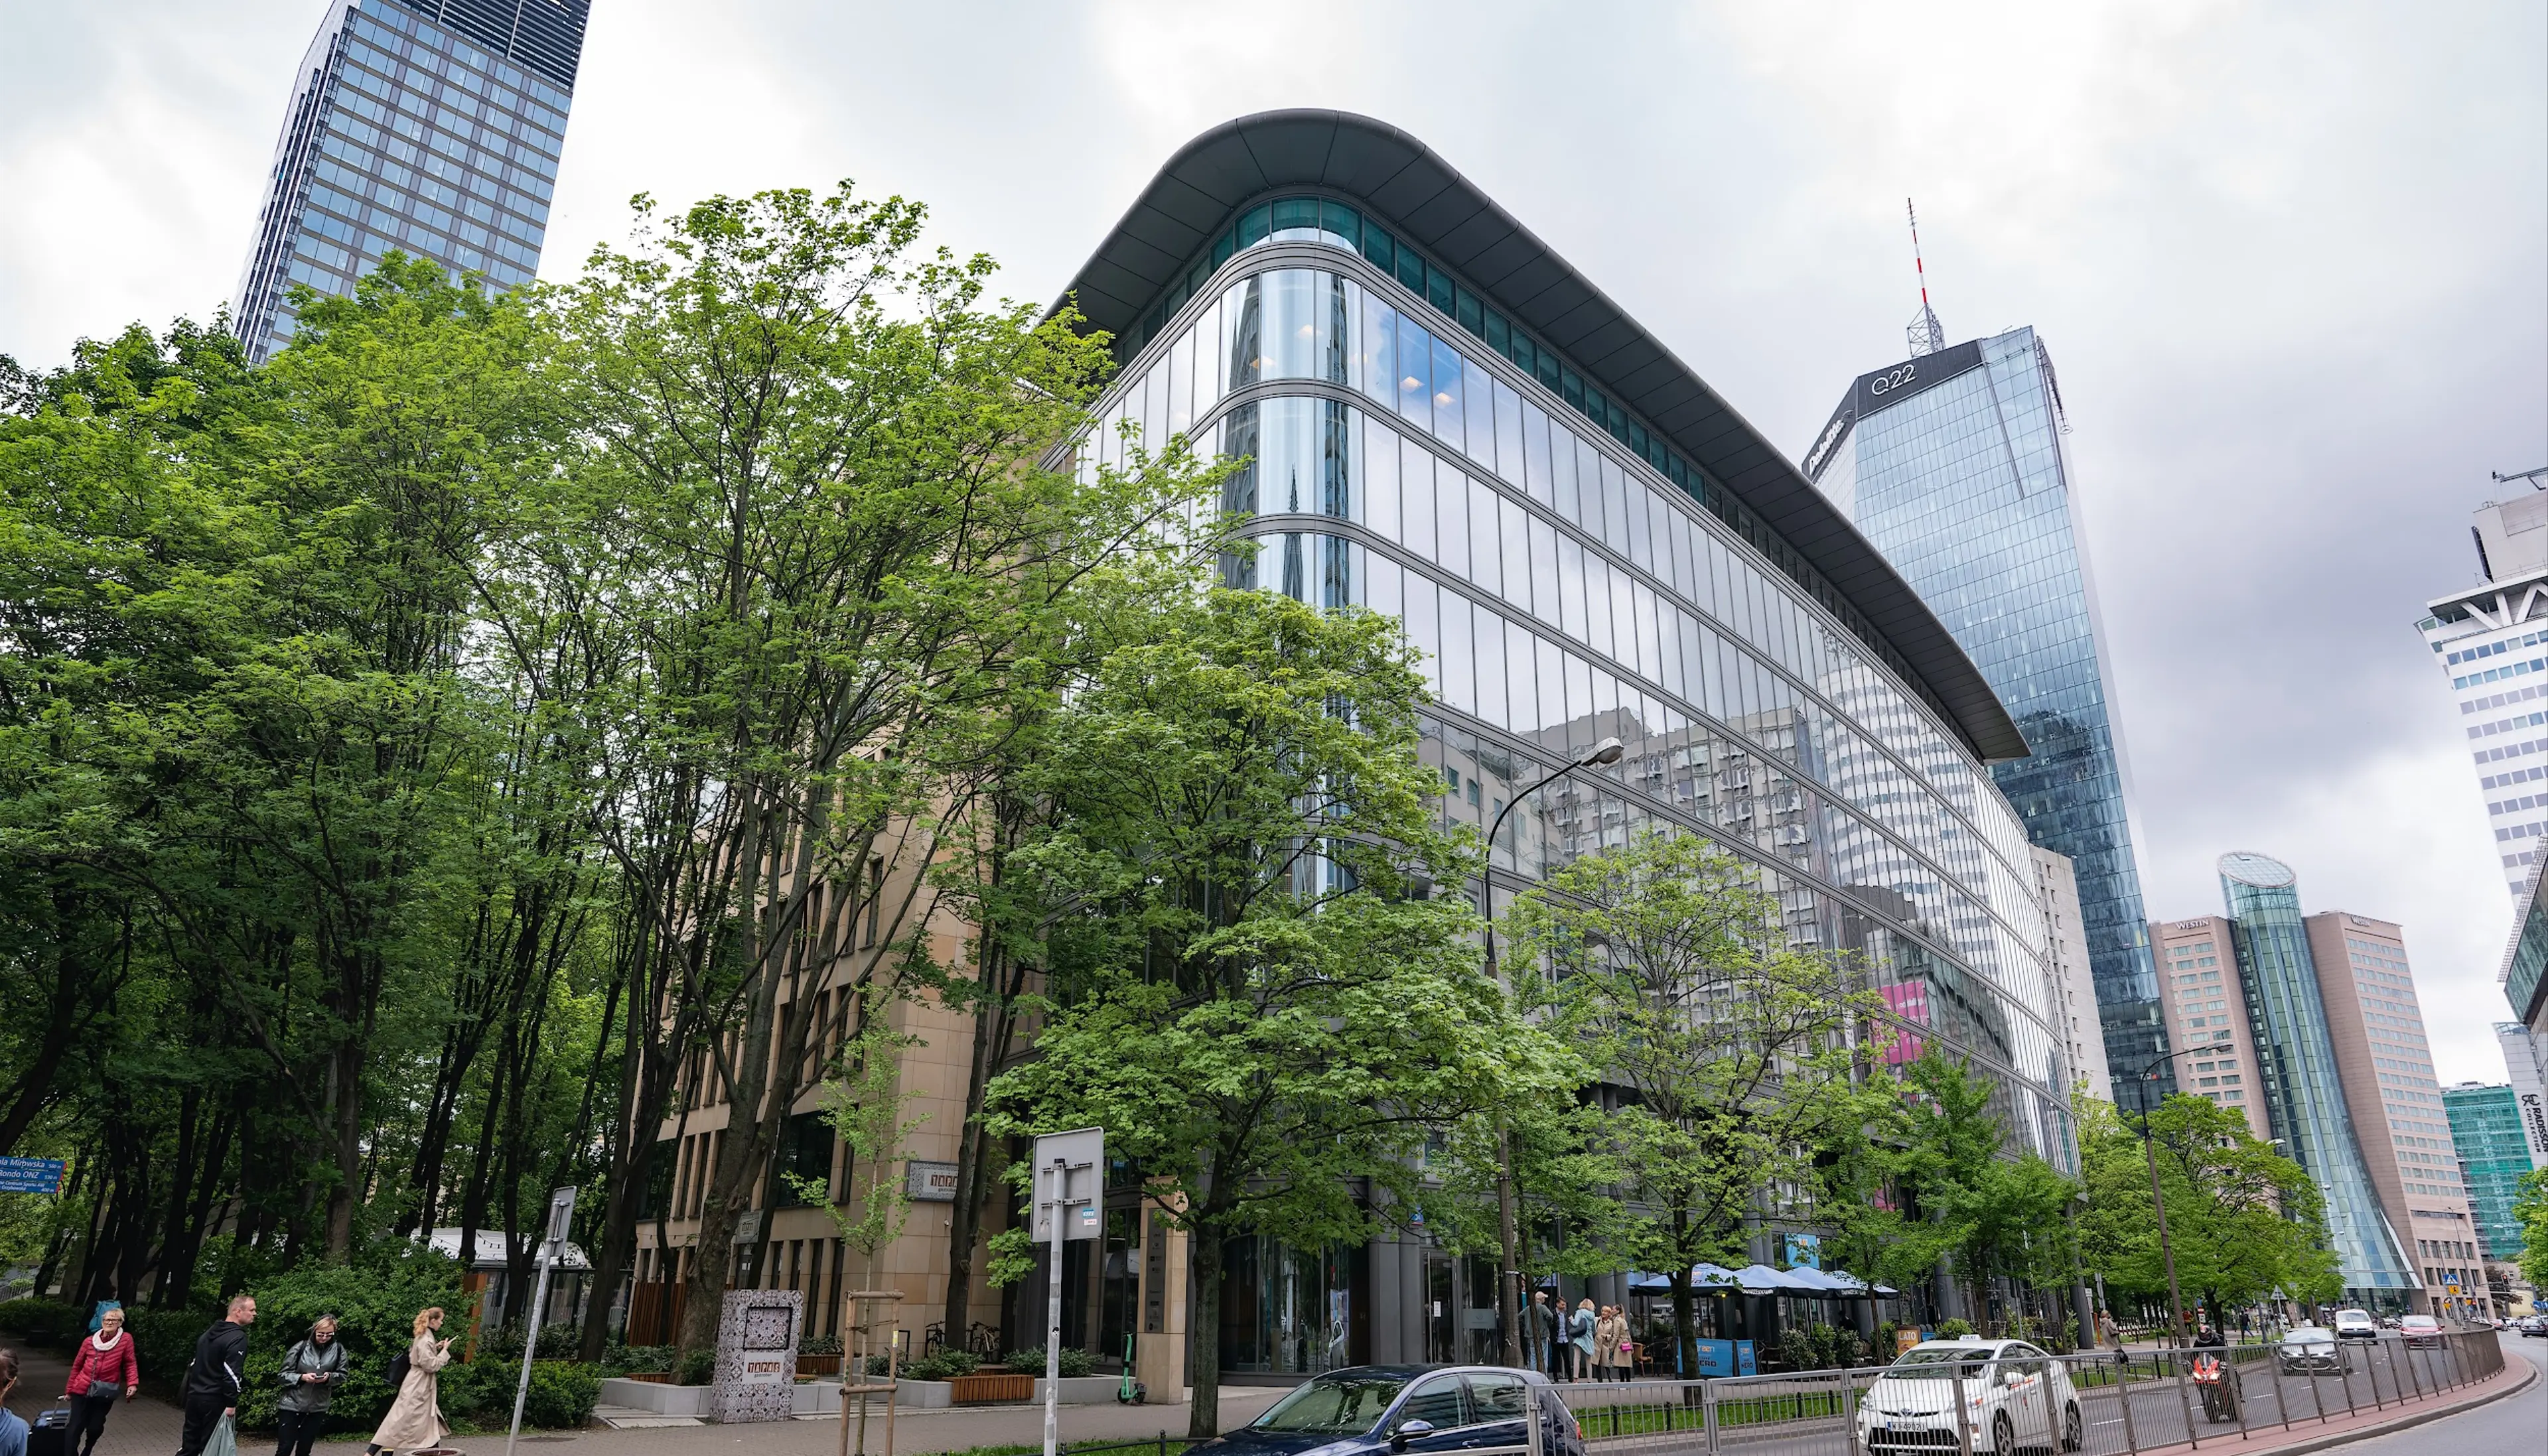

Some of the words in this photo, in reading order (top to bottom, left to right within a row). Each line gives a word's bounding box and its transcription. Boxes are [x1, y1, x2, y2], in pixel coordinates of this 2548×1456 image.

[1872, 364, 1916, 395] Q22
[2176, 919, 2209, 929] WESTIN
[2525, 1108, 2541, 1153] COLLECTION
[9, 1159, 45, 1167] Mirowska
[0, 1169, 21, 1178] Rondo
[930, 1174, 957, 1187] TAPA
[1898, 1331, 1916, 1340] LATO
[748, 1362, 780, 1373] TAPAS
